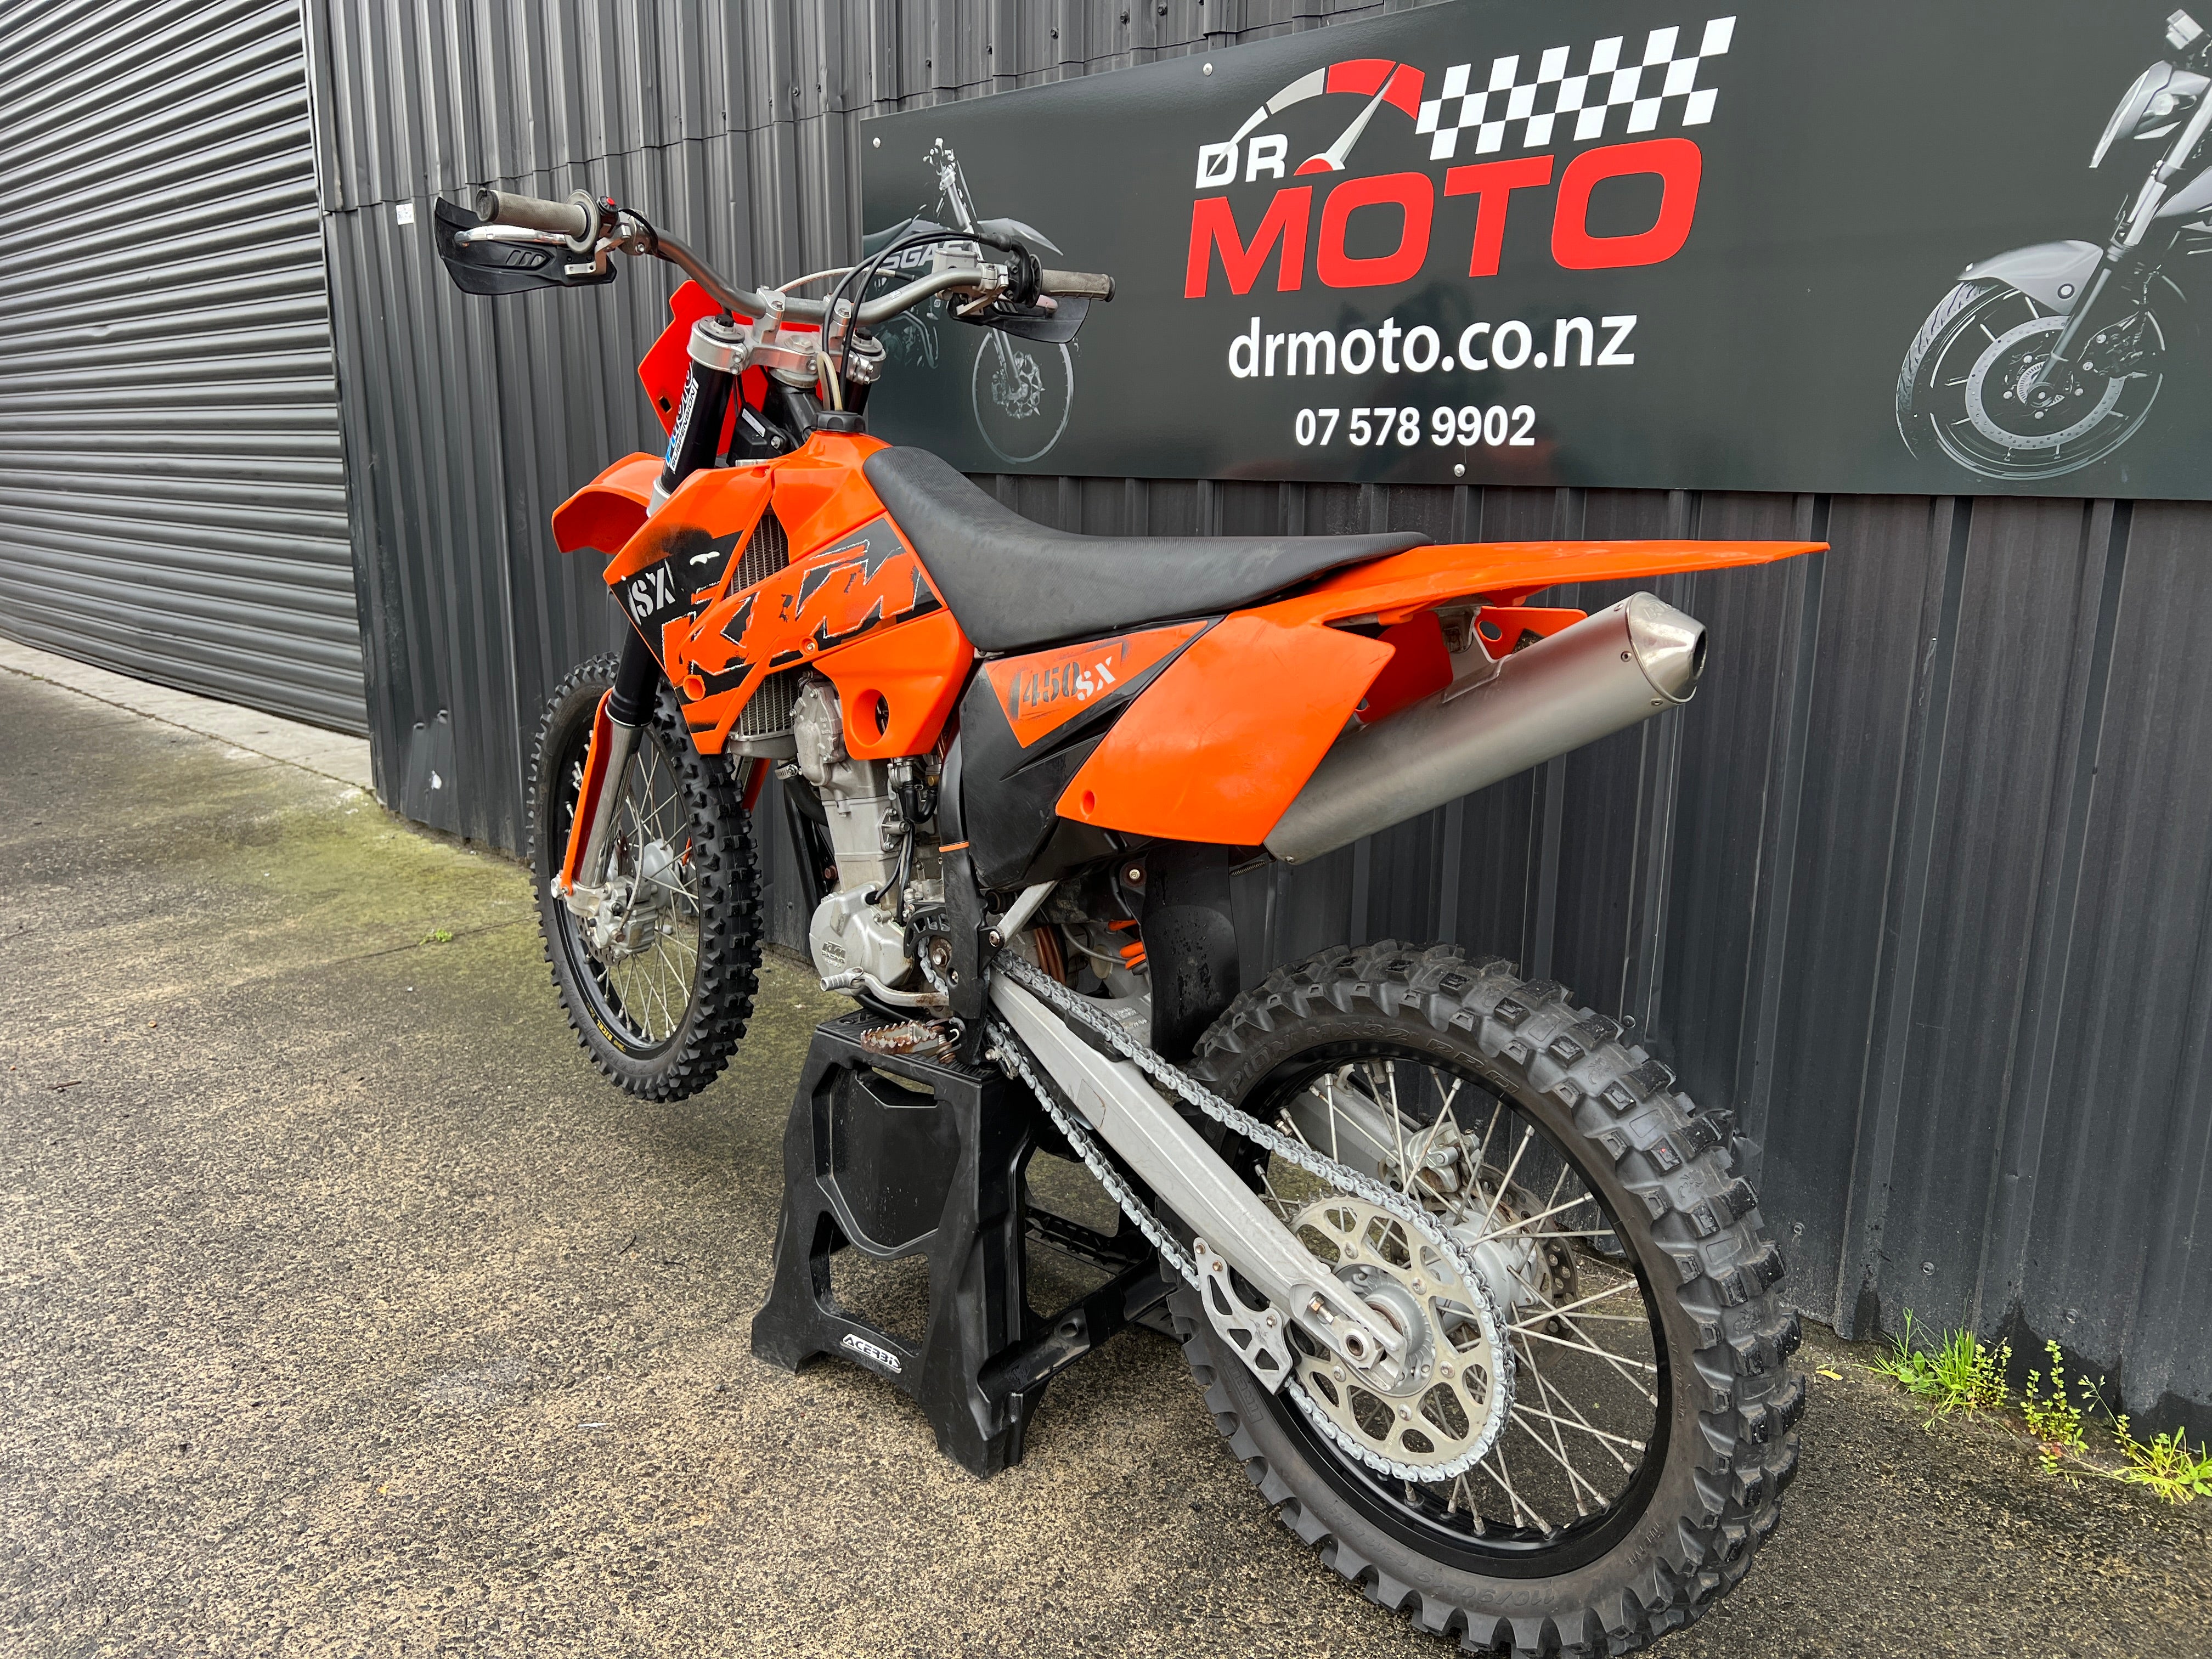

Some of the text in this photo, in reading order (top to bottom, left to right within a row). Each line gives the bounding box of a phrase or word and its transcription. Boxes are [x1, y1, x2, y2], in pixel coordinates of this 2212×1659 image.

[1195, 134, 1288, 189] DR
[1184, 138, 1702, 299] MOTO
[1228, 315, 1637, 379] drmoto.co.nz
[670, 386, 698, 470] SUSPENSION
[1295, 404, 1536, 447] 07 578 9902
[1427, 1039, 1520, 1093] PRO
